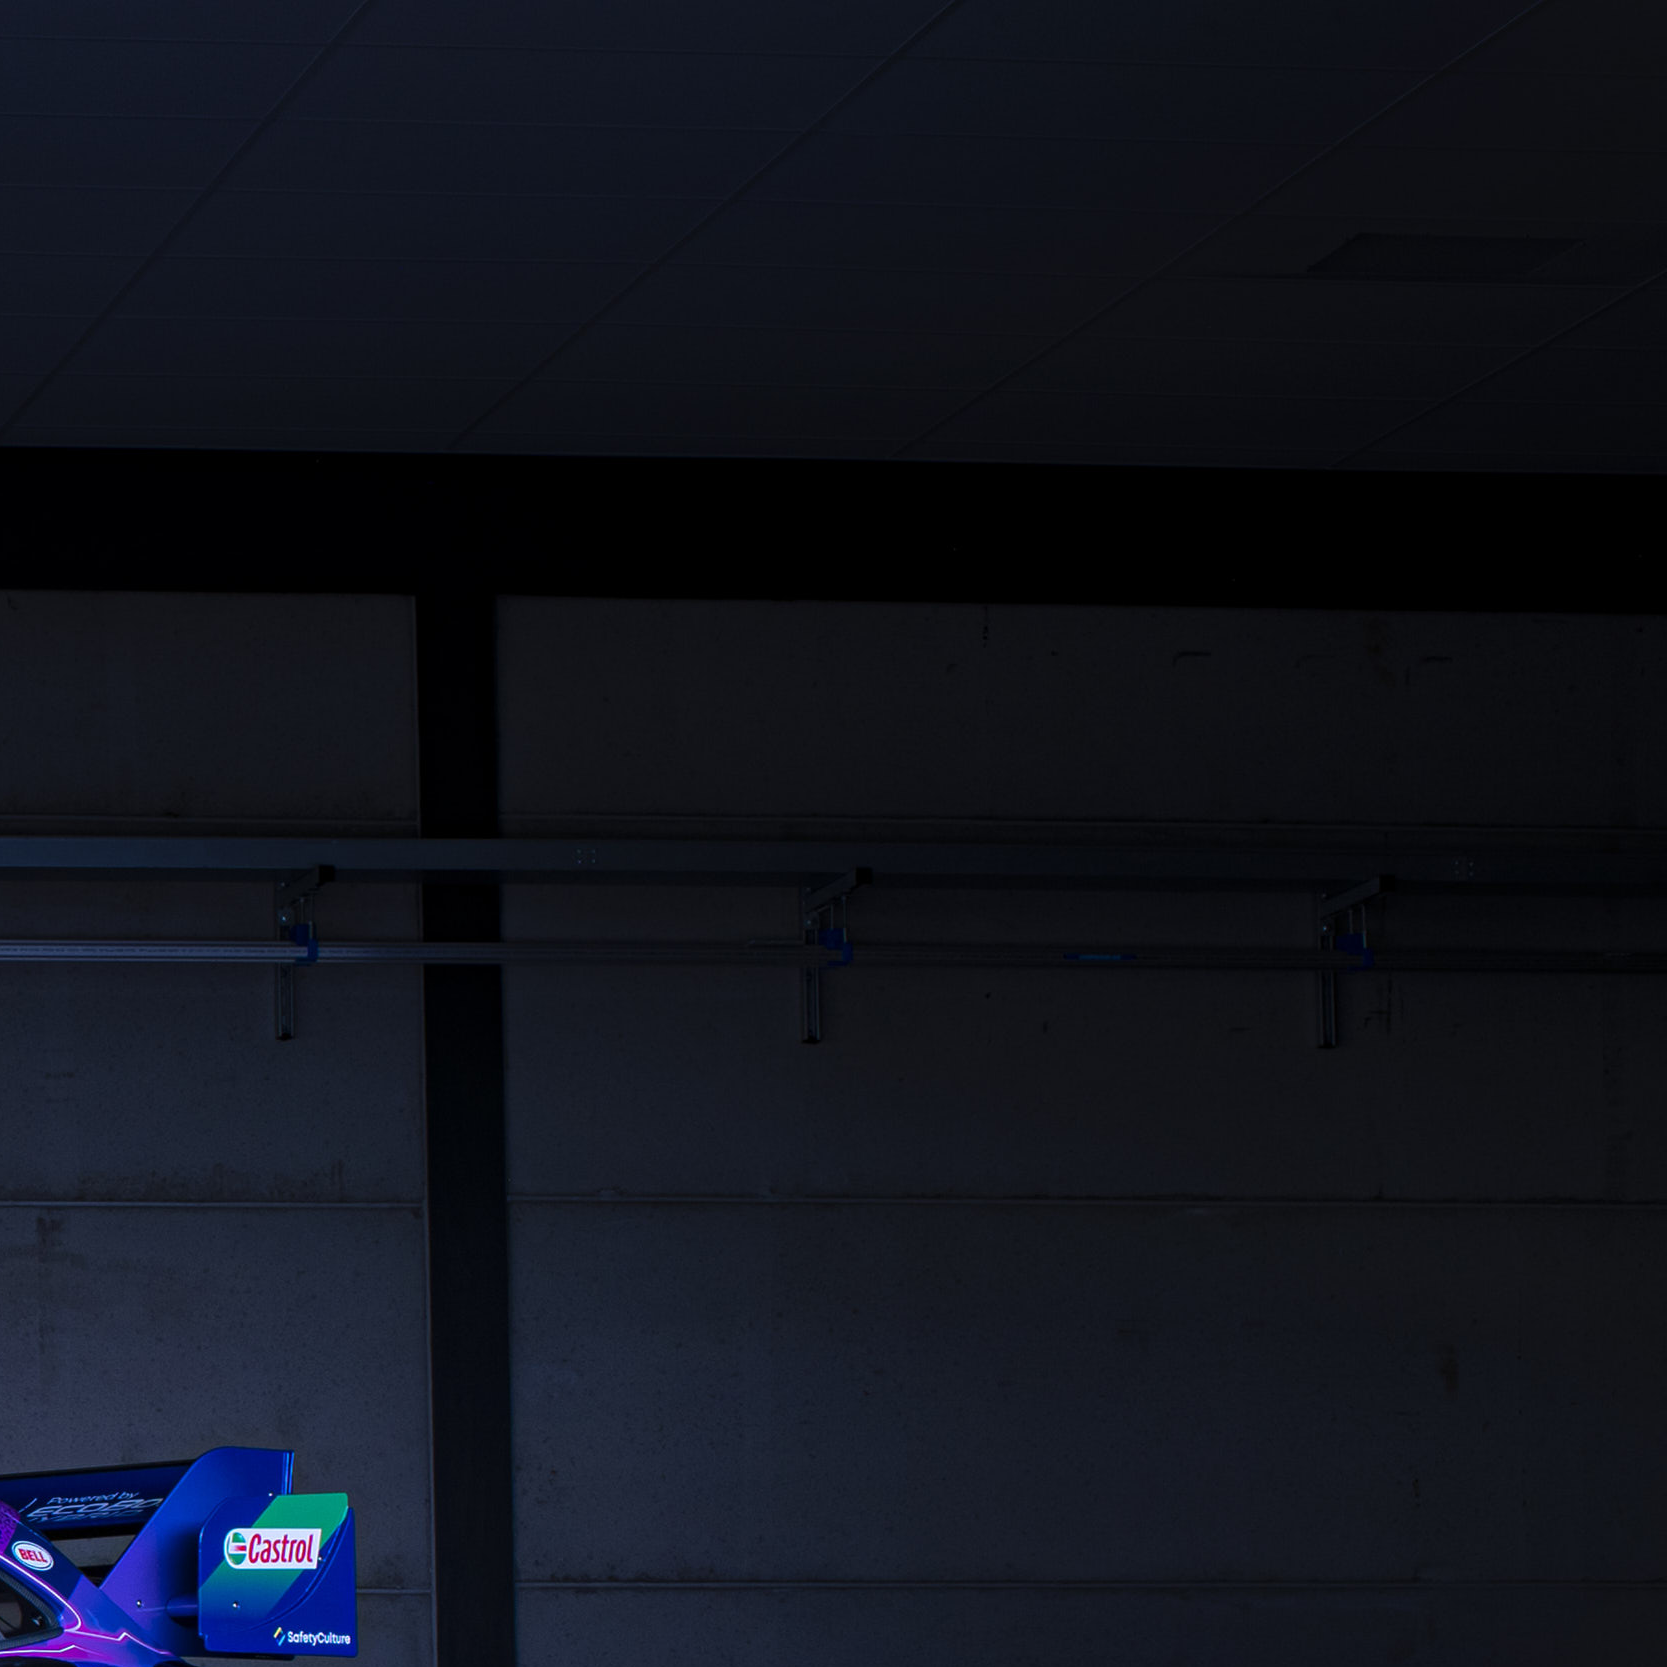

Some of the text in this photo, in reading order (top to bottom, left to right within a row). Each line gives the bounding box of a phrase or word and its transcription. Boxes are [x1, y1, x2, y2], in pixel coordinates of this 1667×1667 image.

[18, 1548, 48, 1563] BELL
[248, 1533, 314, 1564] Castrol
[287, 1630, 351, 1646] SafetyCulture
